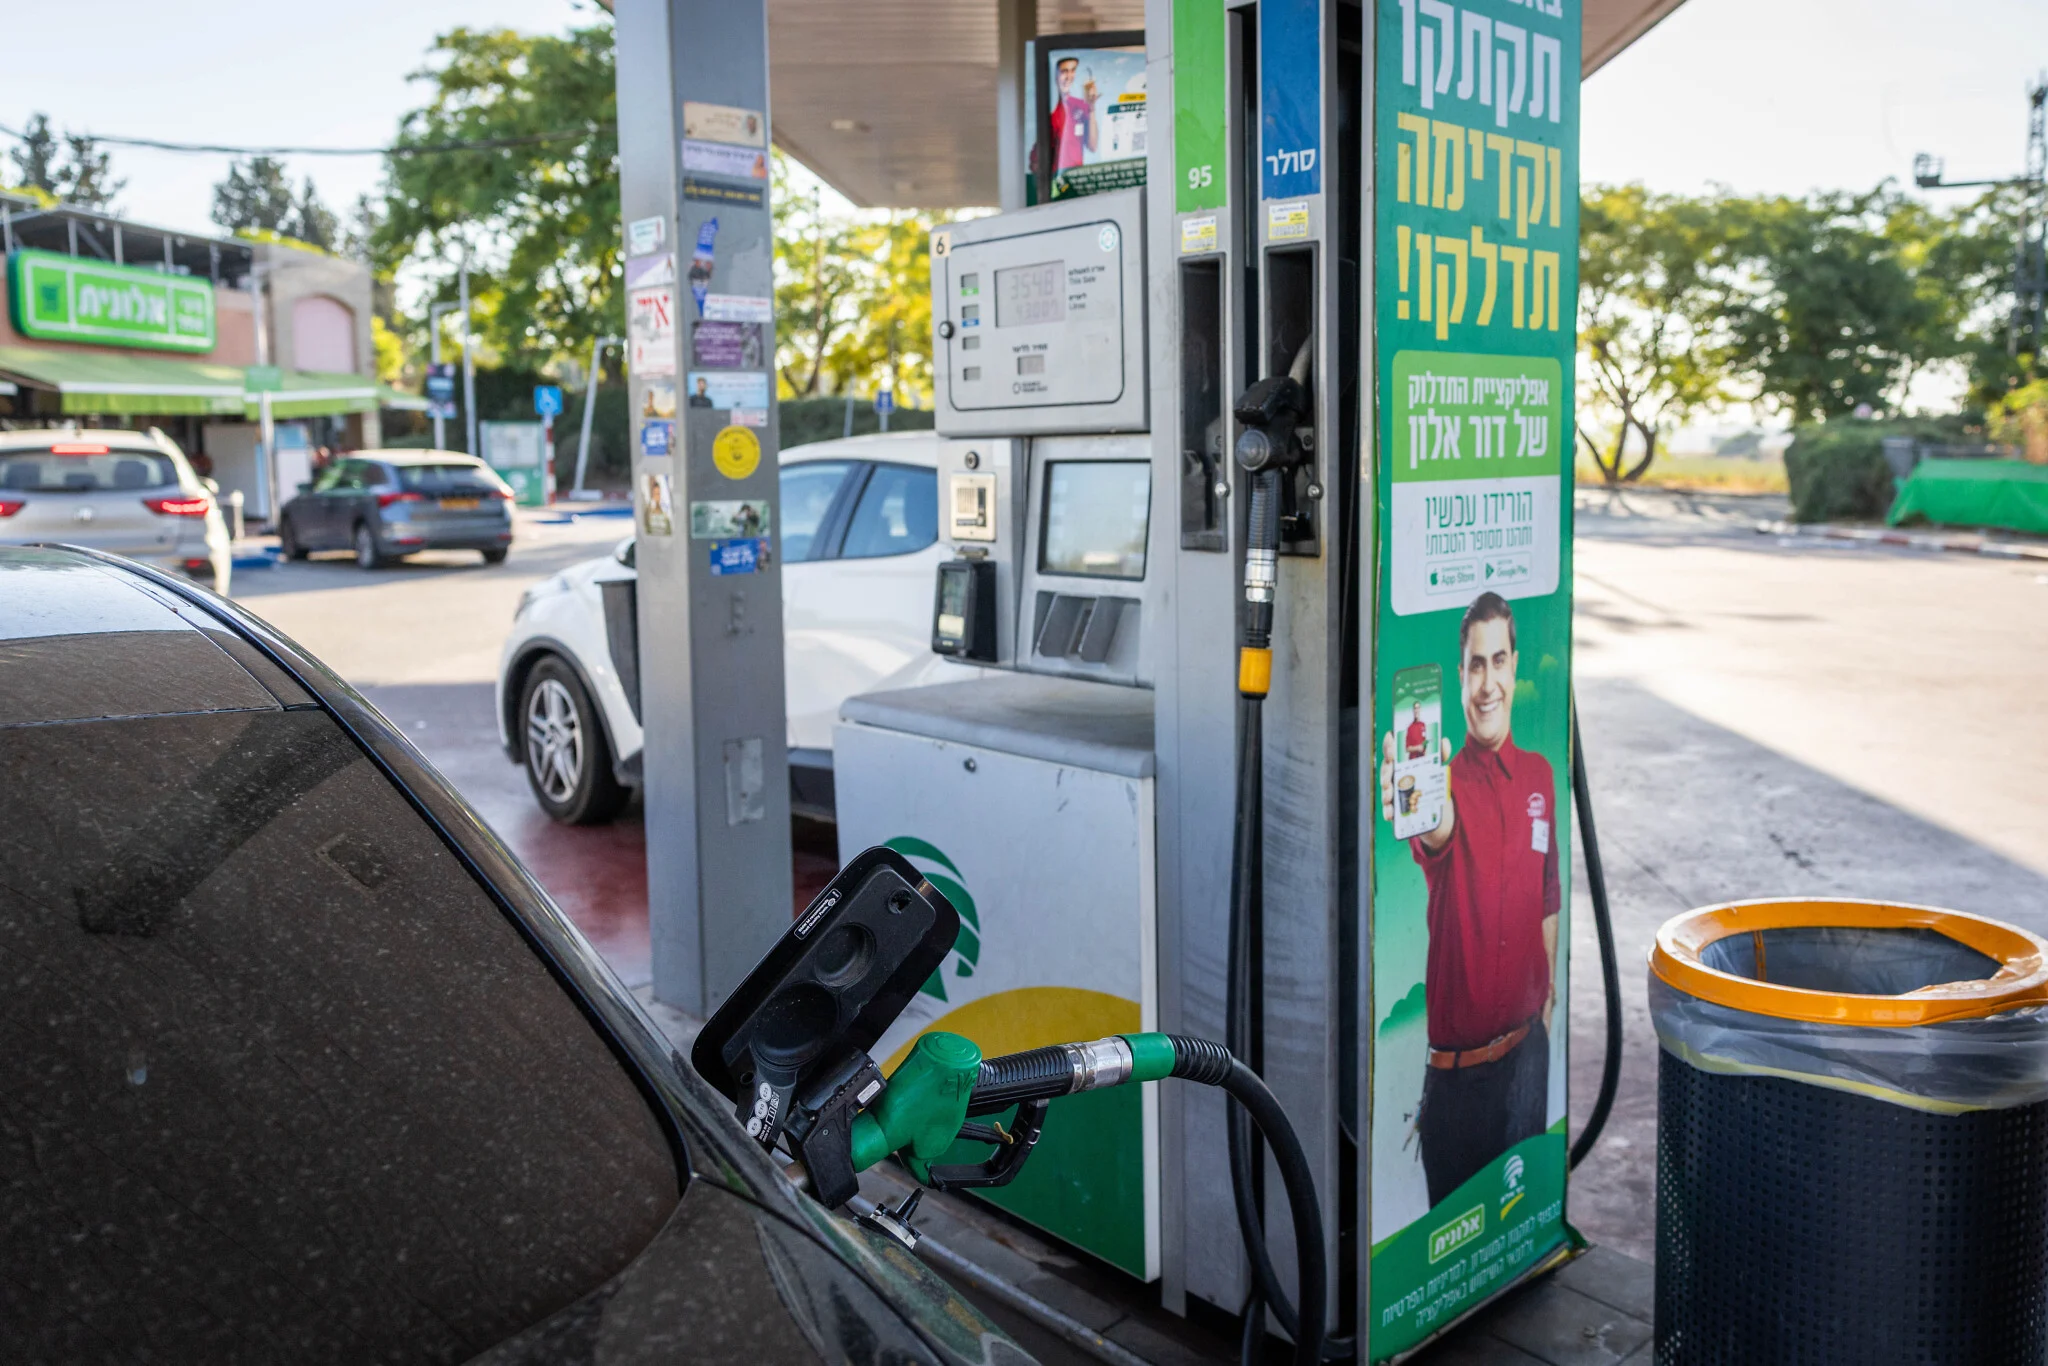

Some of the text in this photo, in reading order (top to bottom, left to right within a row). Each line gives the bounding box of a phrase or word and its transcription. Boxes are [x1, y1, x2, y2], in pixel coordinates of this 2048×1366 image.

[1398, 0, 1561, 128] תקתקו
[1188, 165, 1212, 189] 95
[1266, 148, 1316, 176] סולר
[1397, 112, 1561, 239] וקדימה
[936, 236, 945, 255] 6
[1397, 225, 1559, 340] תדלקו!
[1408, 369, 1549, 411] אפליקציית התדלוק
[1408, 407, 1549, 470] של דור אלון
[1426, 491, 1532, 529] הורידו עכשיו
[1434, 1214, 1480, 1256] אלונית
